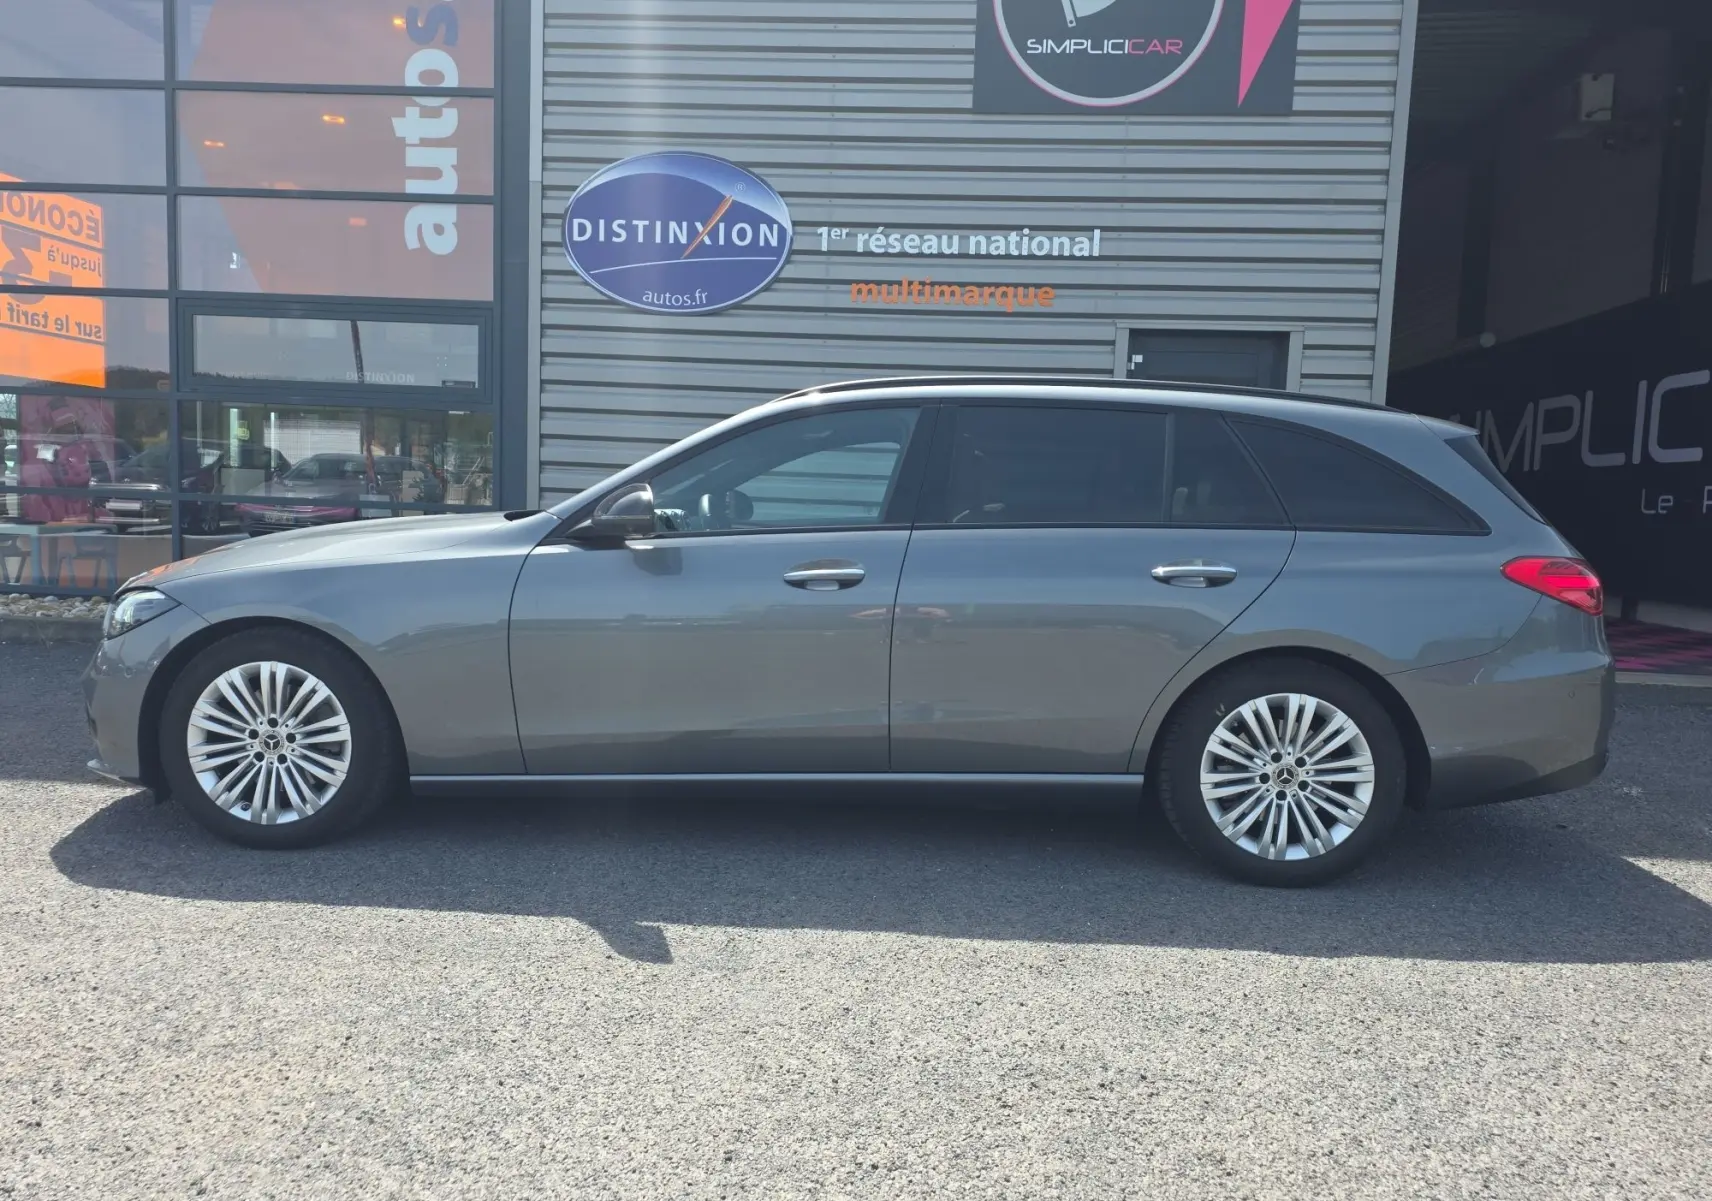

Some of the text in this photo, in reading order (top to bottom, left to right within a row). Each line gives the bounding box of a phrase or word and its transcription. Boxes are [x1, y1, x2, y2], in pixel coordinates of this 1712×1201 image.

[1026, 38, 1183, 54] SIMPLICICAR
[572, 216, 779, 250] DISTINXION
[856, 226, 959, 255] réseau
[969, 228, 1101, 257] national
[642, 289, 708, 306] autos.fr
[851, 276, 1056, 312] multimarque
[1450, 369, 1711, 474] MPLIC
[1640, 488, 1674, 515] Le
